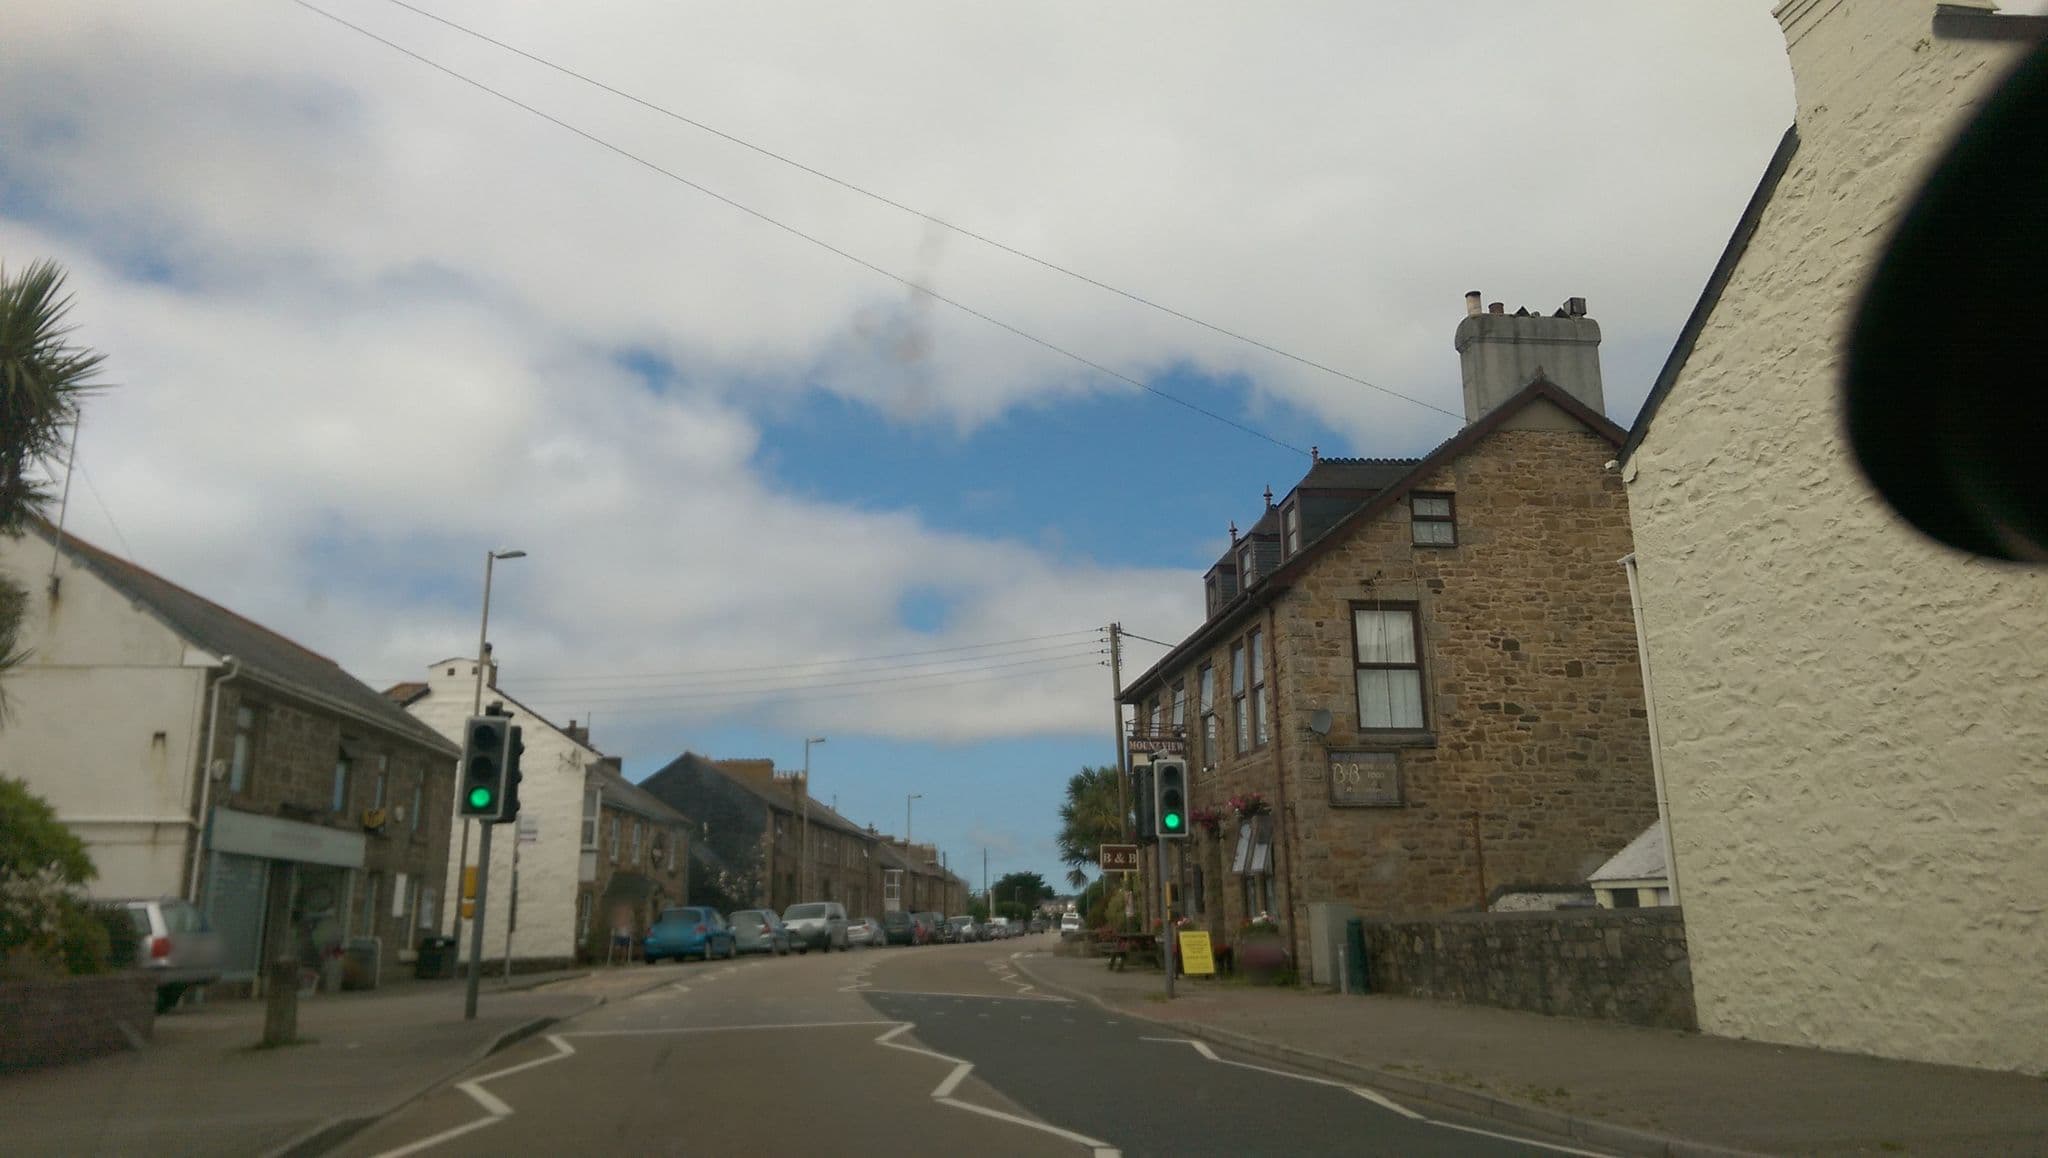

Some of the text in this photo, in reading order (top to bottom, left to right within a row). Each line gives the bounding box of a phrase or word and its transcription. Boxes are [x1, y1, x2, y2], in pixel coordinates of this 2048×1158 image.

[1161, 741, 1184, 752] VIEW
[1103, 852, 1137, 864] B & B
